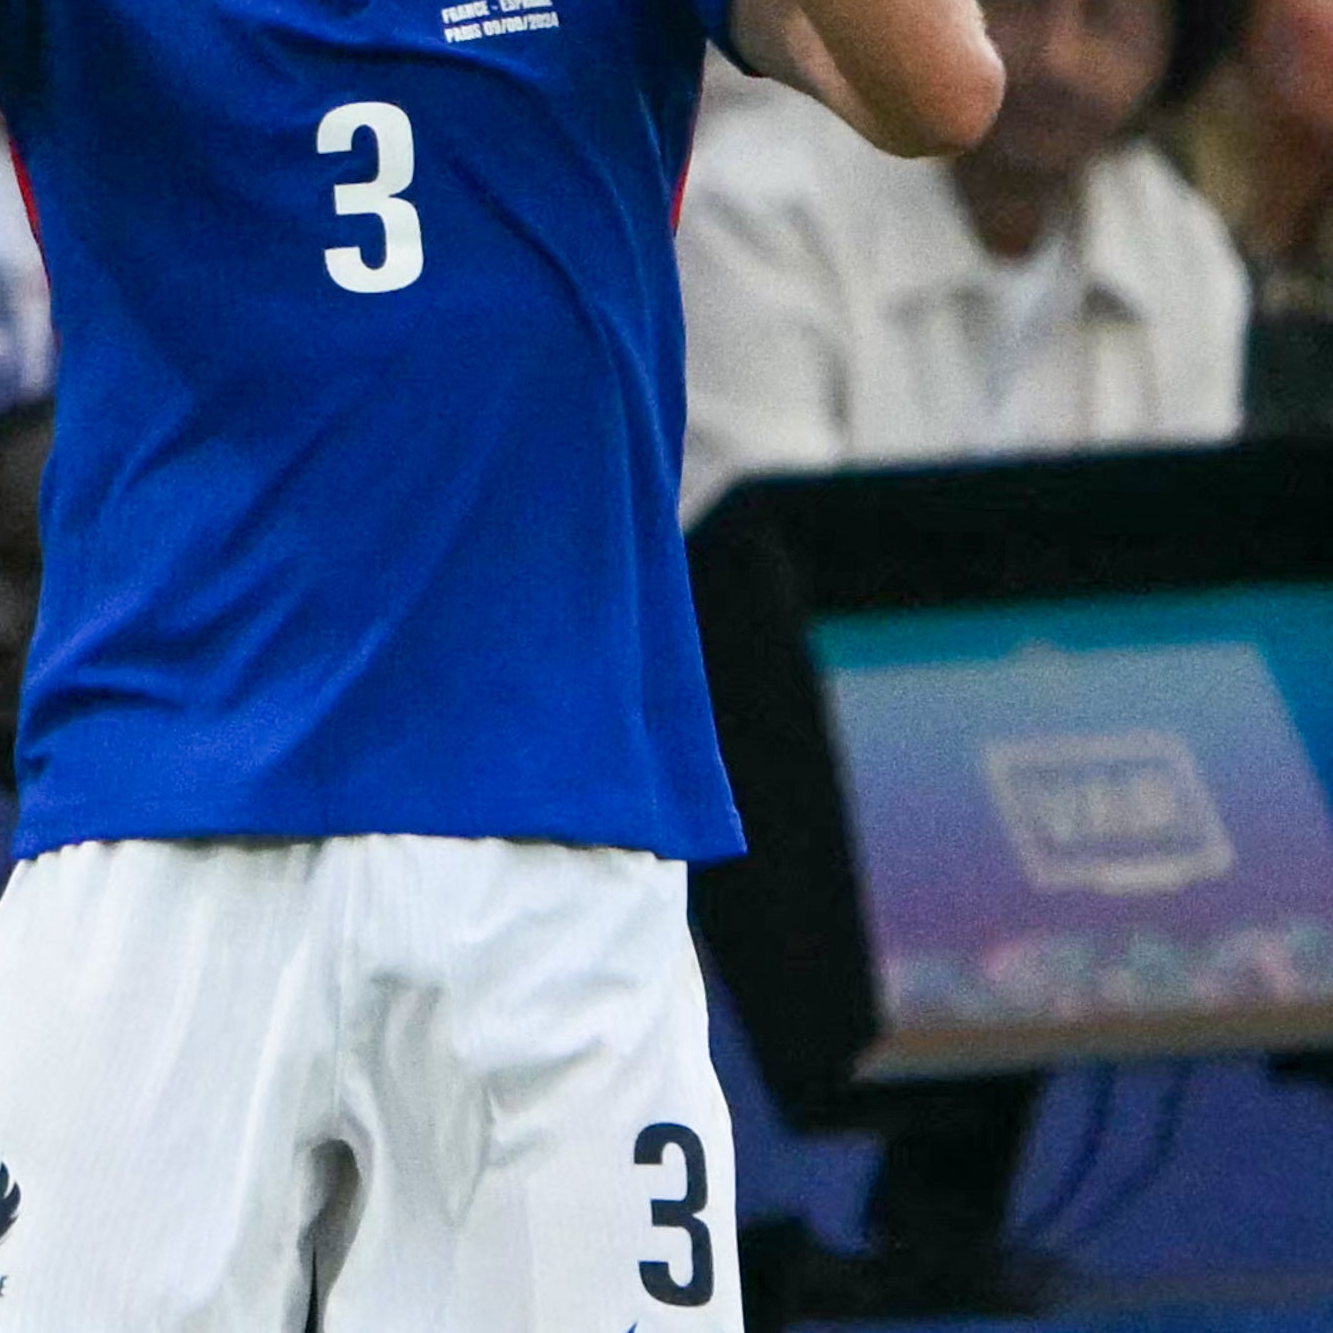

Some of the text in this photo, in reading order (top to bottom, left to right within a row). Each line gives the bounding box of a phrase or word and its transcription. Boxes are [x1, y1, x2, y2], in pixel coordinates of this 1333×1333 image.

[441, 0, 490, 24] FRANCE
[444, 23, 482, 43] PARIS
[317, 101, 424, 293] 3
[633, 1122, 714, 1307] 3
